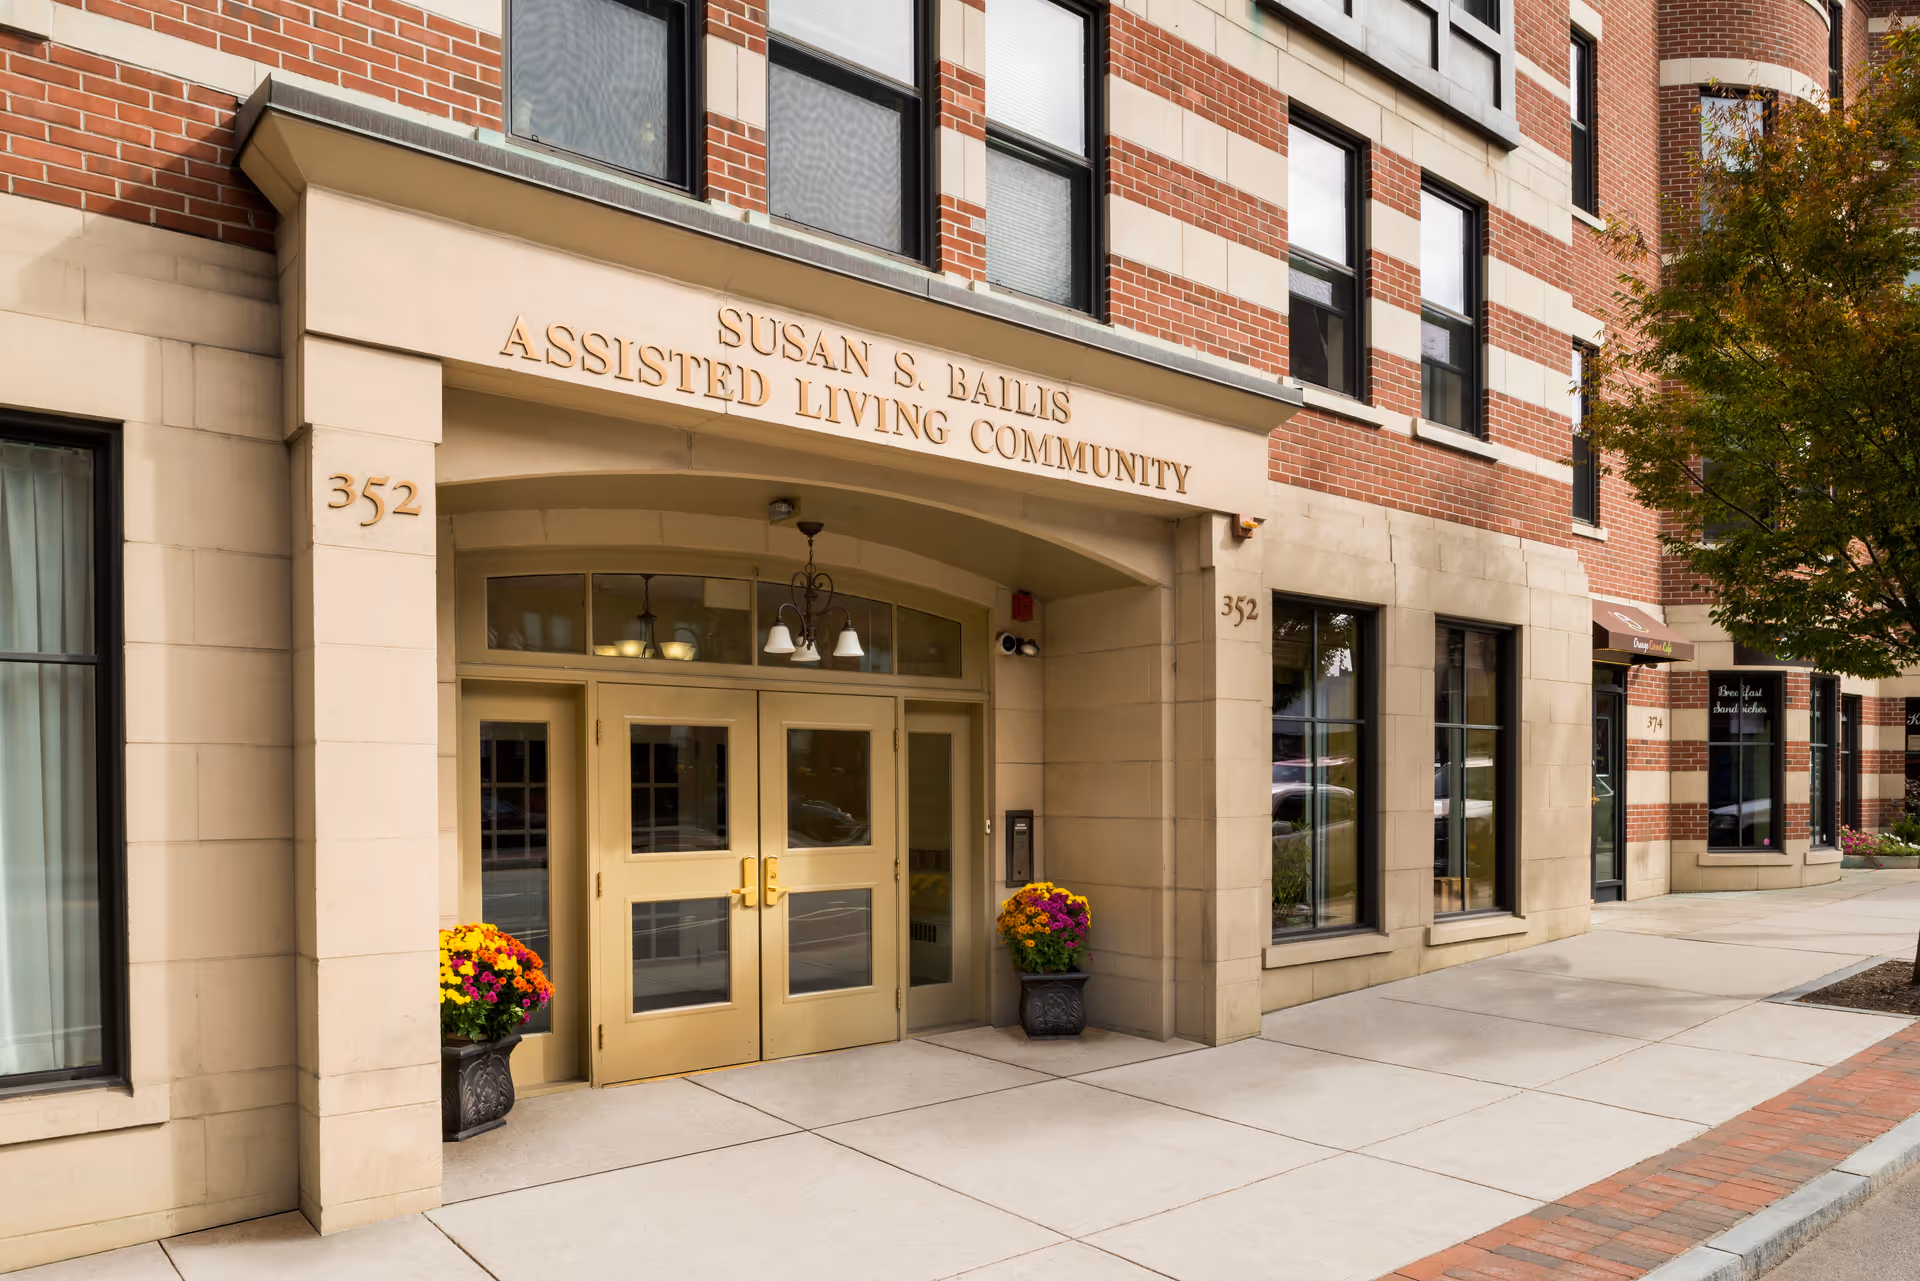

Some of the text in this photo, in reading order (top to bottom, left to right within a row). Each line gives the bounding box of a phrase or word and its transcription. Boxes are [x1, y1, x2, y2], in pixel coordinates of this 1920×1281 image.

[717, 304, 1072, 424] SUSAN S. BAILIS
[499, 314, 1192, 495] ASSISTED LIVING COMMUNITY
[327, 473, 423, 527] 352
[1221, 594, 1259, 628] 352
[1633, 637, 1649, 653] Orange
[1647, 716, 1663, 734] 374
